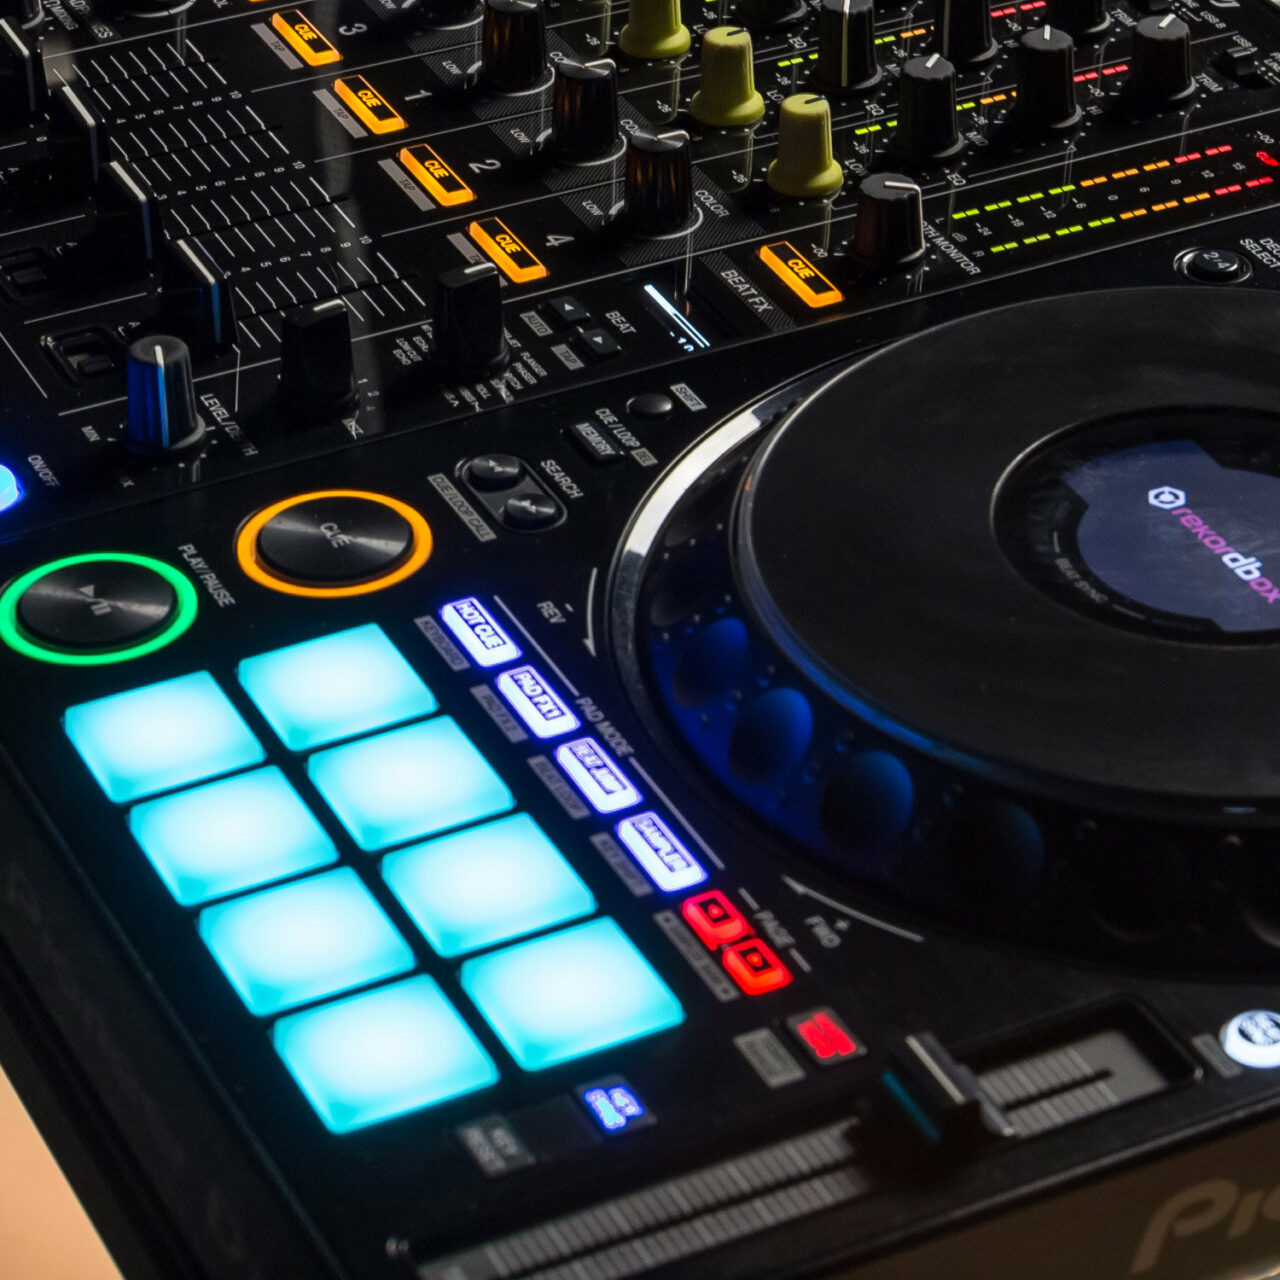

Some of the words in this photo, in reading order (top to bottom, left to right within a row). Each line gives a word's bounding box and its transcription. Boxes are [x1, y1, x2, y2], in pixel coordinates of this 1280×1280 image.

[53, 9, 79, 31] MIXING
[1111, 8, 1138, 27] TRIM
[294, 22, 317, 41] CUE
[339, 23, 367, 37] 3
[788, 36, 808, 49] EQ
[1195, 72, 1223, 94] TRIM
[357, 88, 381, 108] CUE
[404, 90, 432, 102] 1
[865, 103, 885, 117] EQ
[510, 129, 530, 143] LOW
[966, 131, 990, 147] MID
[292, 160, 306, 170] 10
[424, 158, 450, 179] CUE
[468, 159, 502, 174] 2
[948, 173, 967, 187] EQ
[582, 200, 604, 216] LOW
[695, 190, 730, 218] COLOR
[359, 235, 373, 245] 10
[495, 233, 522, 254] CUE
[544, 234, 576, 247] 4
[933, 238, 981, 275] MONITOR
[787, 258, 816, 279] CUE
[721, 270, 757, 300] BEAT
[748, 293, 774, 312] FX
[527, 315, 548, 335] AUTO
[605, 310, 637, 335] BEAT
[392, 348, 412, 366] ECHO
[520, 351, 547, 377] FLANGER
[559, 348, 579, 366] TAP
[512, 362, 538, 384] PHASER
[675, 387, 701, 407] SHIFT
[81, 425, 101, 442] MIN
[575, 423, 617, 456] MEMORY
[28, 454, 61, 488] ON/OFF
[540, 459, 584, 500] SEARCH
[319, 521, 349, 549] CUE
[178, 542, 236, 609] PLAY/PAUSE
[537, 600, 567, 624] REV
[593, 720, 635, 756] MODE
